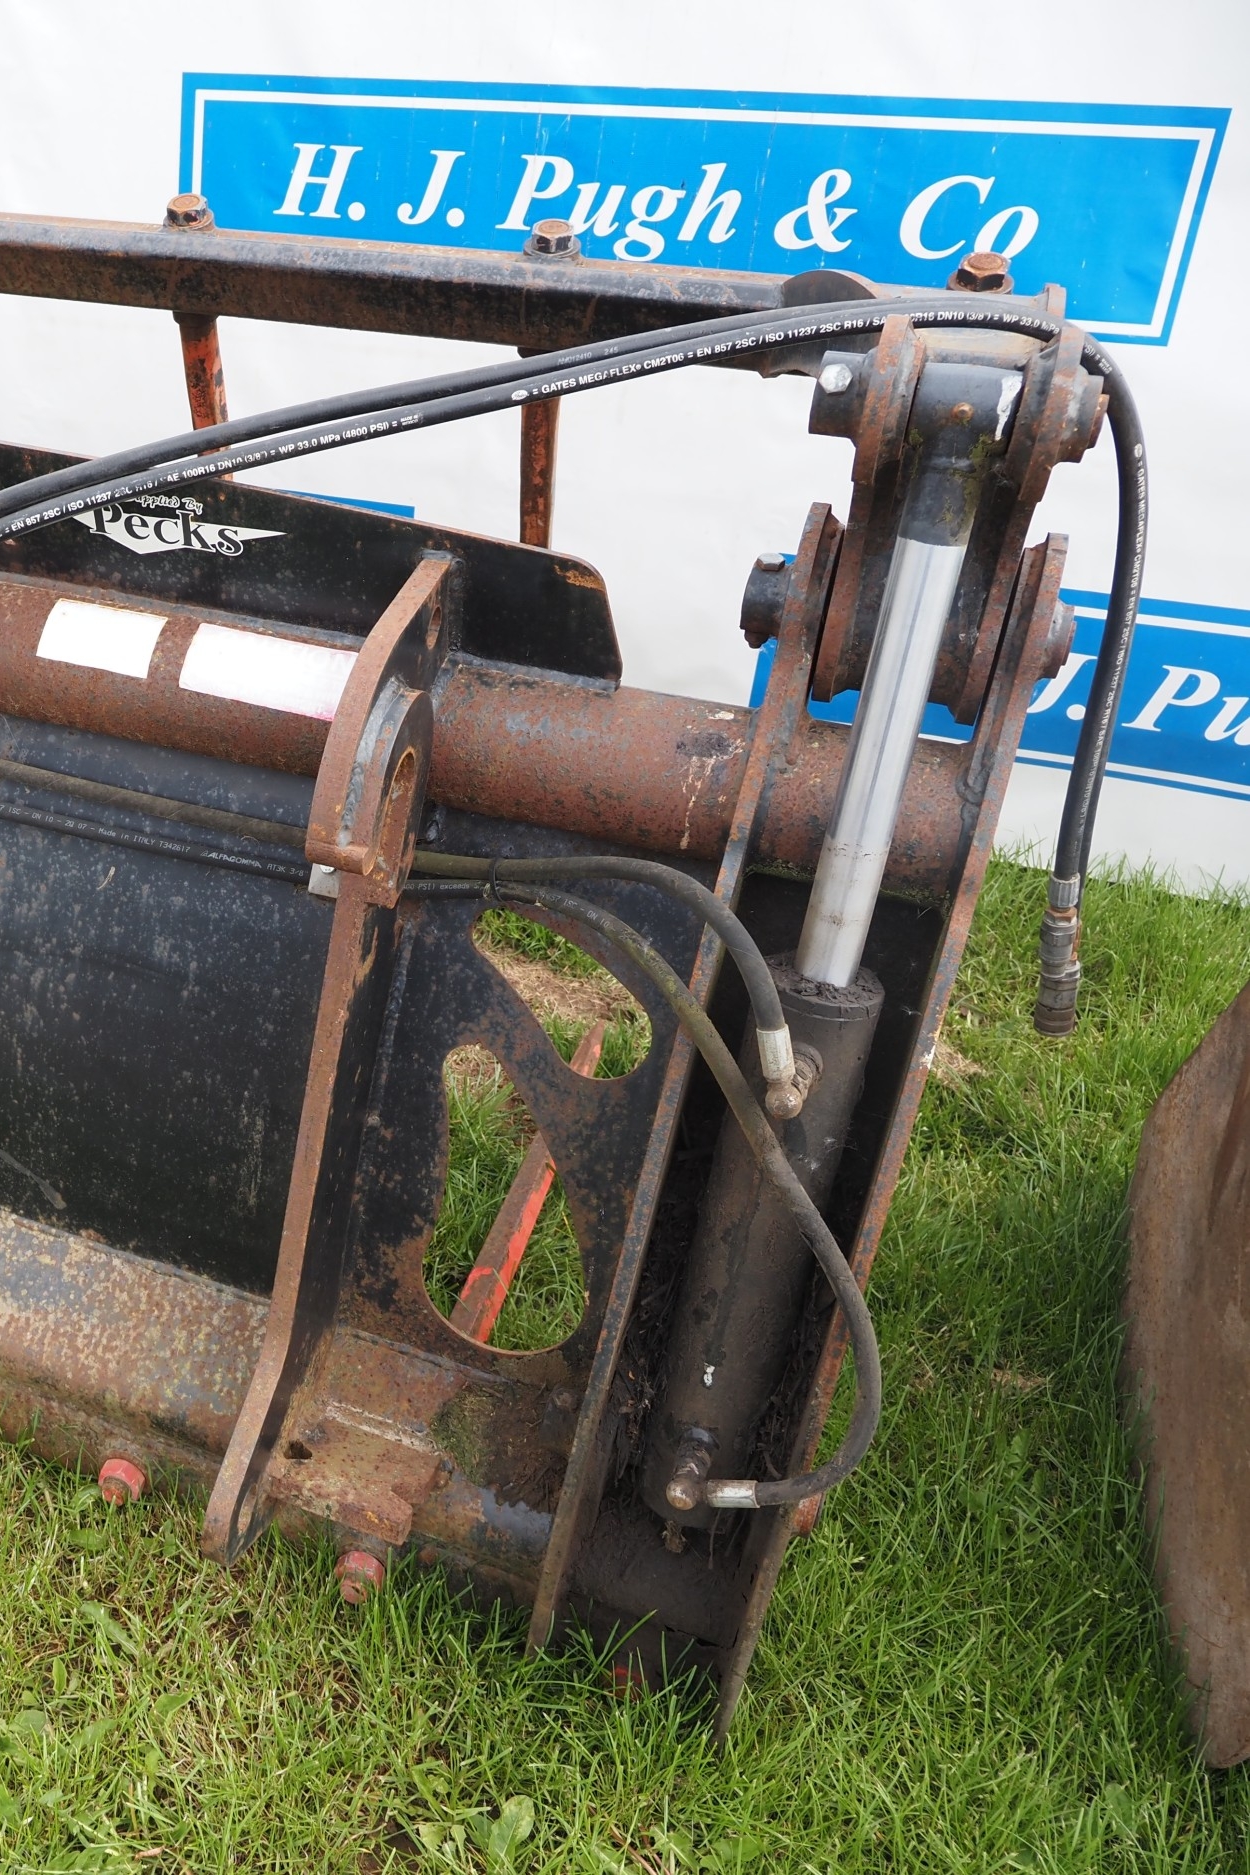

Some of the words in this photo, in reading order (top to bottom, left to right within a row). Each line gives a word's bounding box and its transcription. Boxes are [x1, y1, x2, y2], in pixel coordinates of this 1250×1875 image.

[274, 142, 366, 220] H.
[397, 149, 467, 229] J.
[496, 153, 738, 262] Pugh
[774, 167, 858, 254] &
[899, 174, 1040, 260] Co
[541, 379, 577, 394] GATES
[643, 352, 684, 370] CM2T06
[697, 346, 712, 358] EN
[714, 342, 732, 353] 857
[735, 337, 757, 350] 2SC
[765, 331, 785, 343] ISO
[787, 327, 817, 339] 11237
[819, 323, 842, 335] 2SC
[844, 318, 864, 330] R16
[872, 316, 886, 327] SA
[937, 311, 965, 321] DN10
[1002, 313, 1019, 323] WP
[1020, 316, 1040, 328] 33.0
[11, 521, 25, 532] EN
[26, 513, 41, 526] 857
[42, 507, 62, 520] 2SC
[68, 500, 84, 512] ISO
[86, 491, 112, 507] 11237
[182, 464, 216, 480] 100R16
[278, 442, 295, 455] WP
[297, 438, 318, 450] 33.0
[320, 432, 341, 445] MPa
[343, 425, 368, 441] (4800
[369, 420, 390, 434] PSI)
[90, 505, 244, 557] Pecks
[98, 827, 117, 838] Made
[120, 831, 130, 840] in
[133, 834, 156, 847] ITALY
[207, 852, 262, 869] ALFAGOMMA
